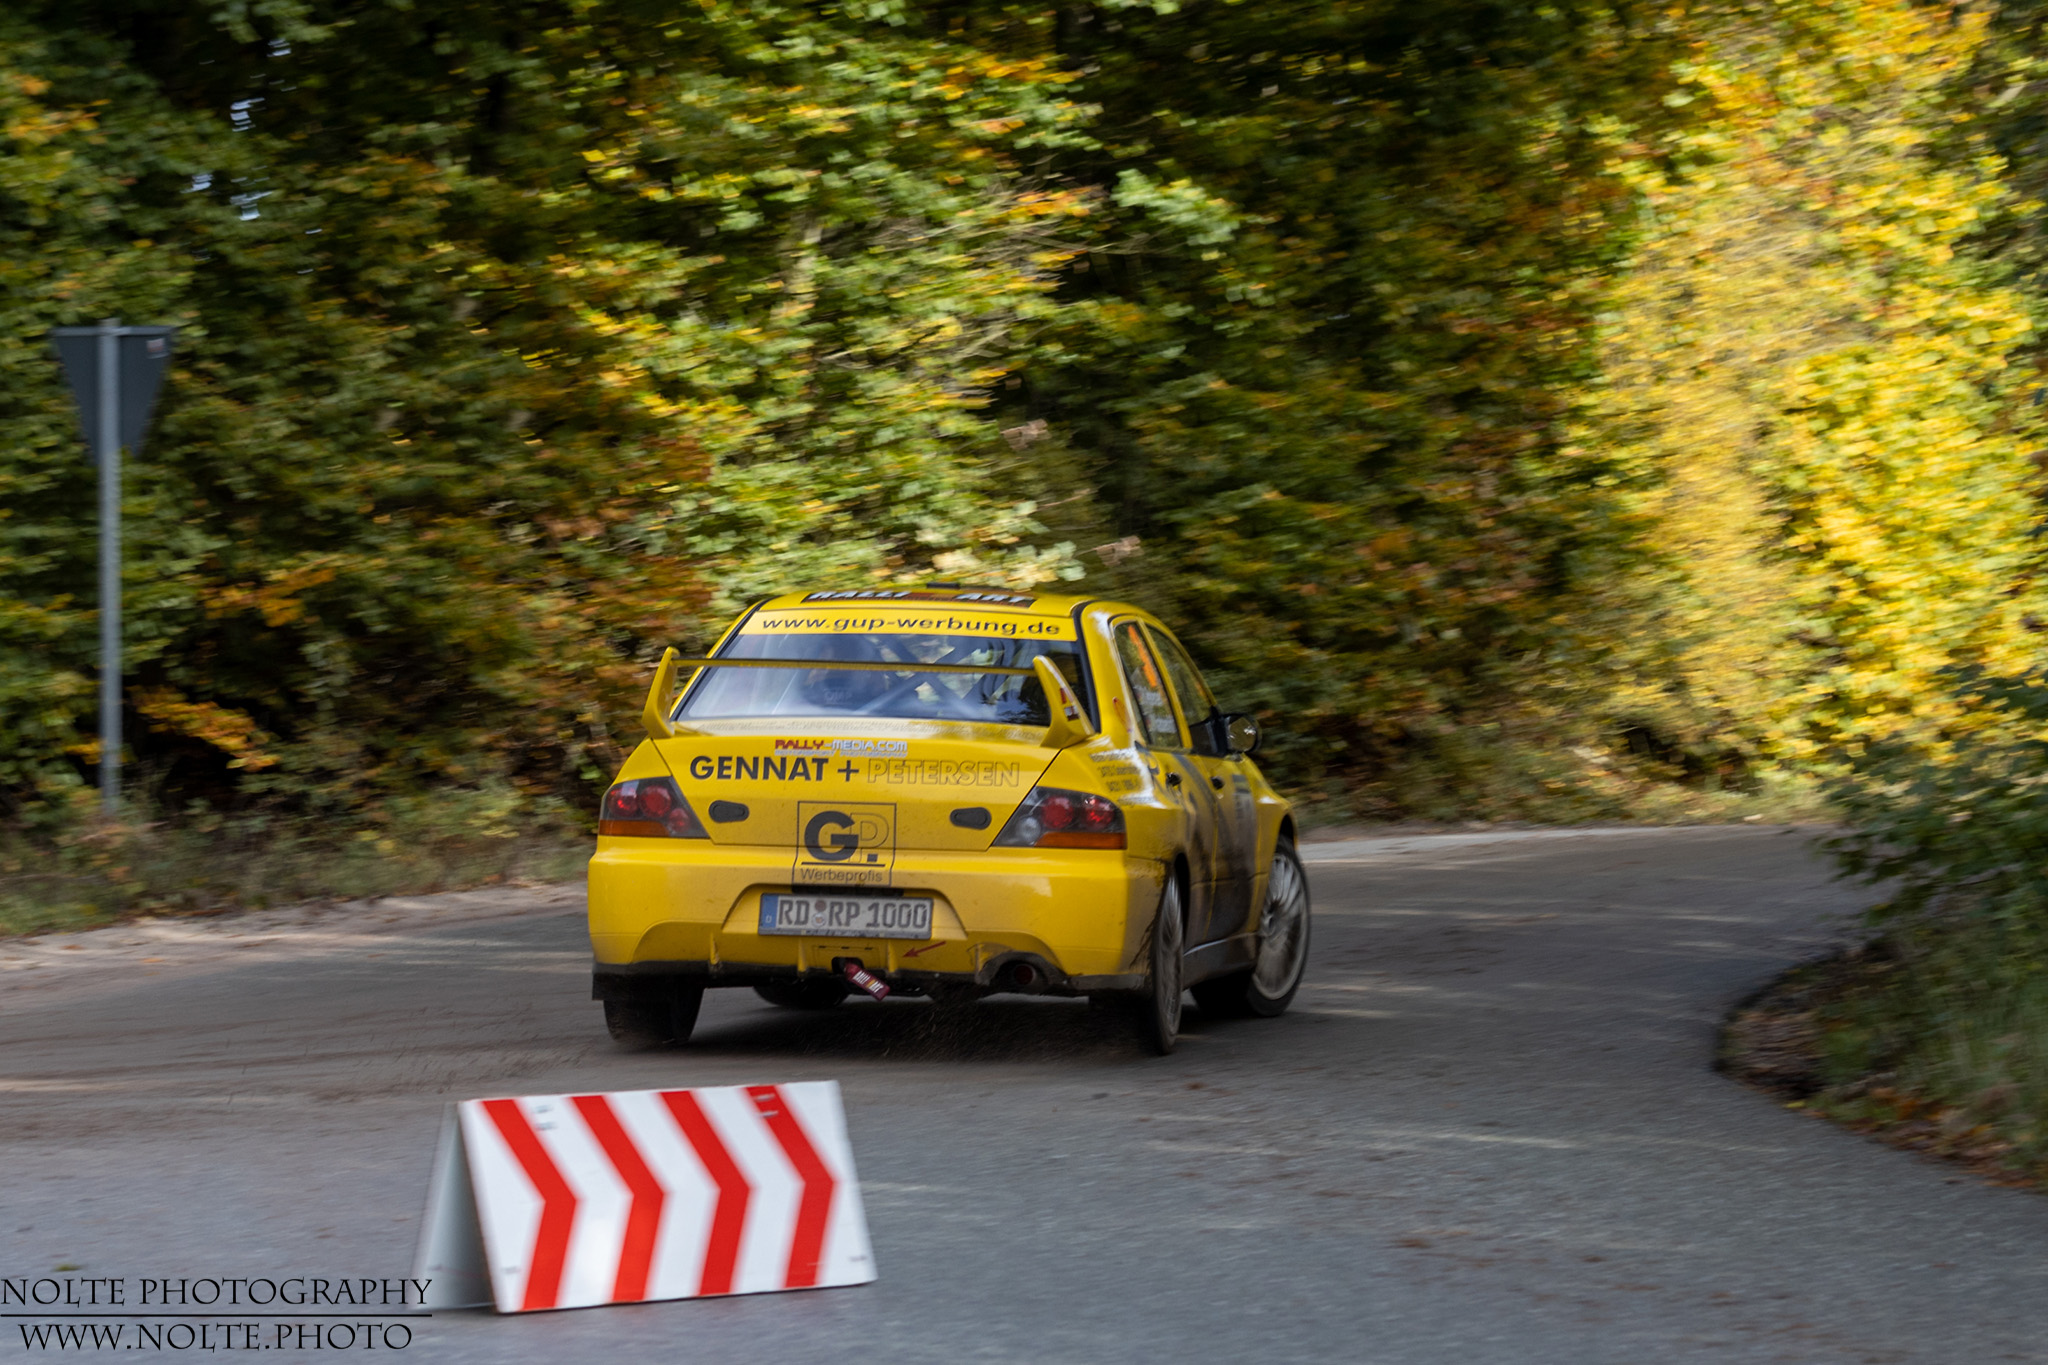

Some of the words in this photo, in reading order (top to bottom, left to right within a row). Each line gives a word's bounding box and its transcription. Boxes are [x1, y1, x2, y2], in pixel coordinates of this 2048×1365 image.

[762, 616, 1060, 635] www.gup-werbung.de
[774, 739, 907, 752] RALLY-MEDIA.COM
[690, 755, 829, 782] GENNAT
[837, 760, 860, 782] +
[867, 758, 1020, 787] PETERSEN
[800, 868, 883, 884] Werbeprofis
[778, 900, 810, 925] RD
[829, 901, 860, 927] RP
[866, 902, 927, 928] 1000
